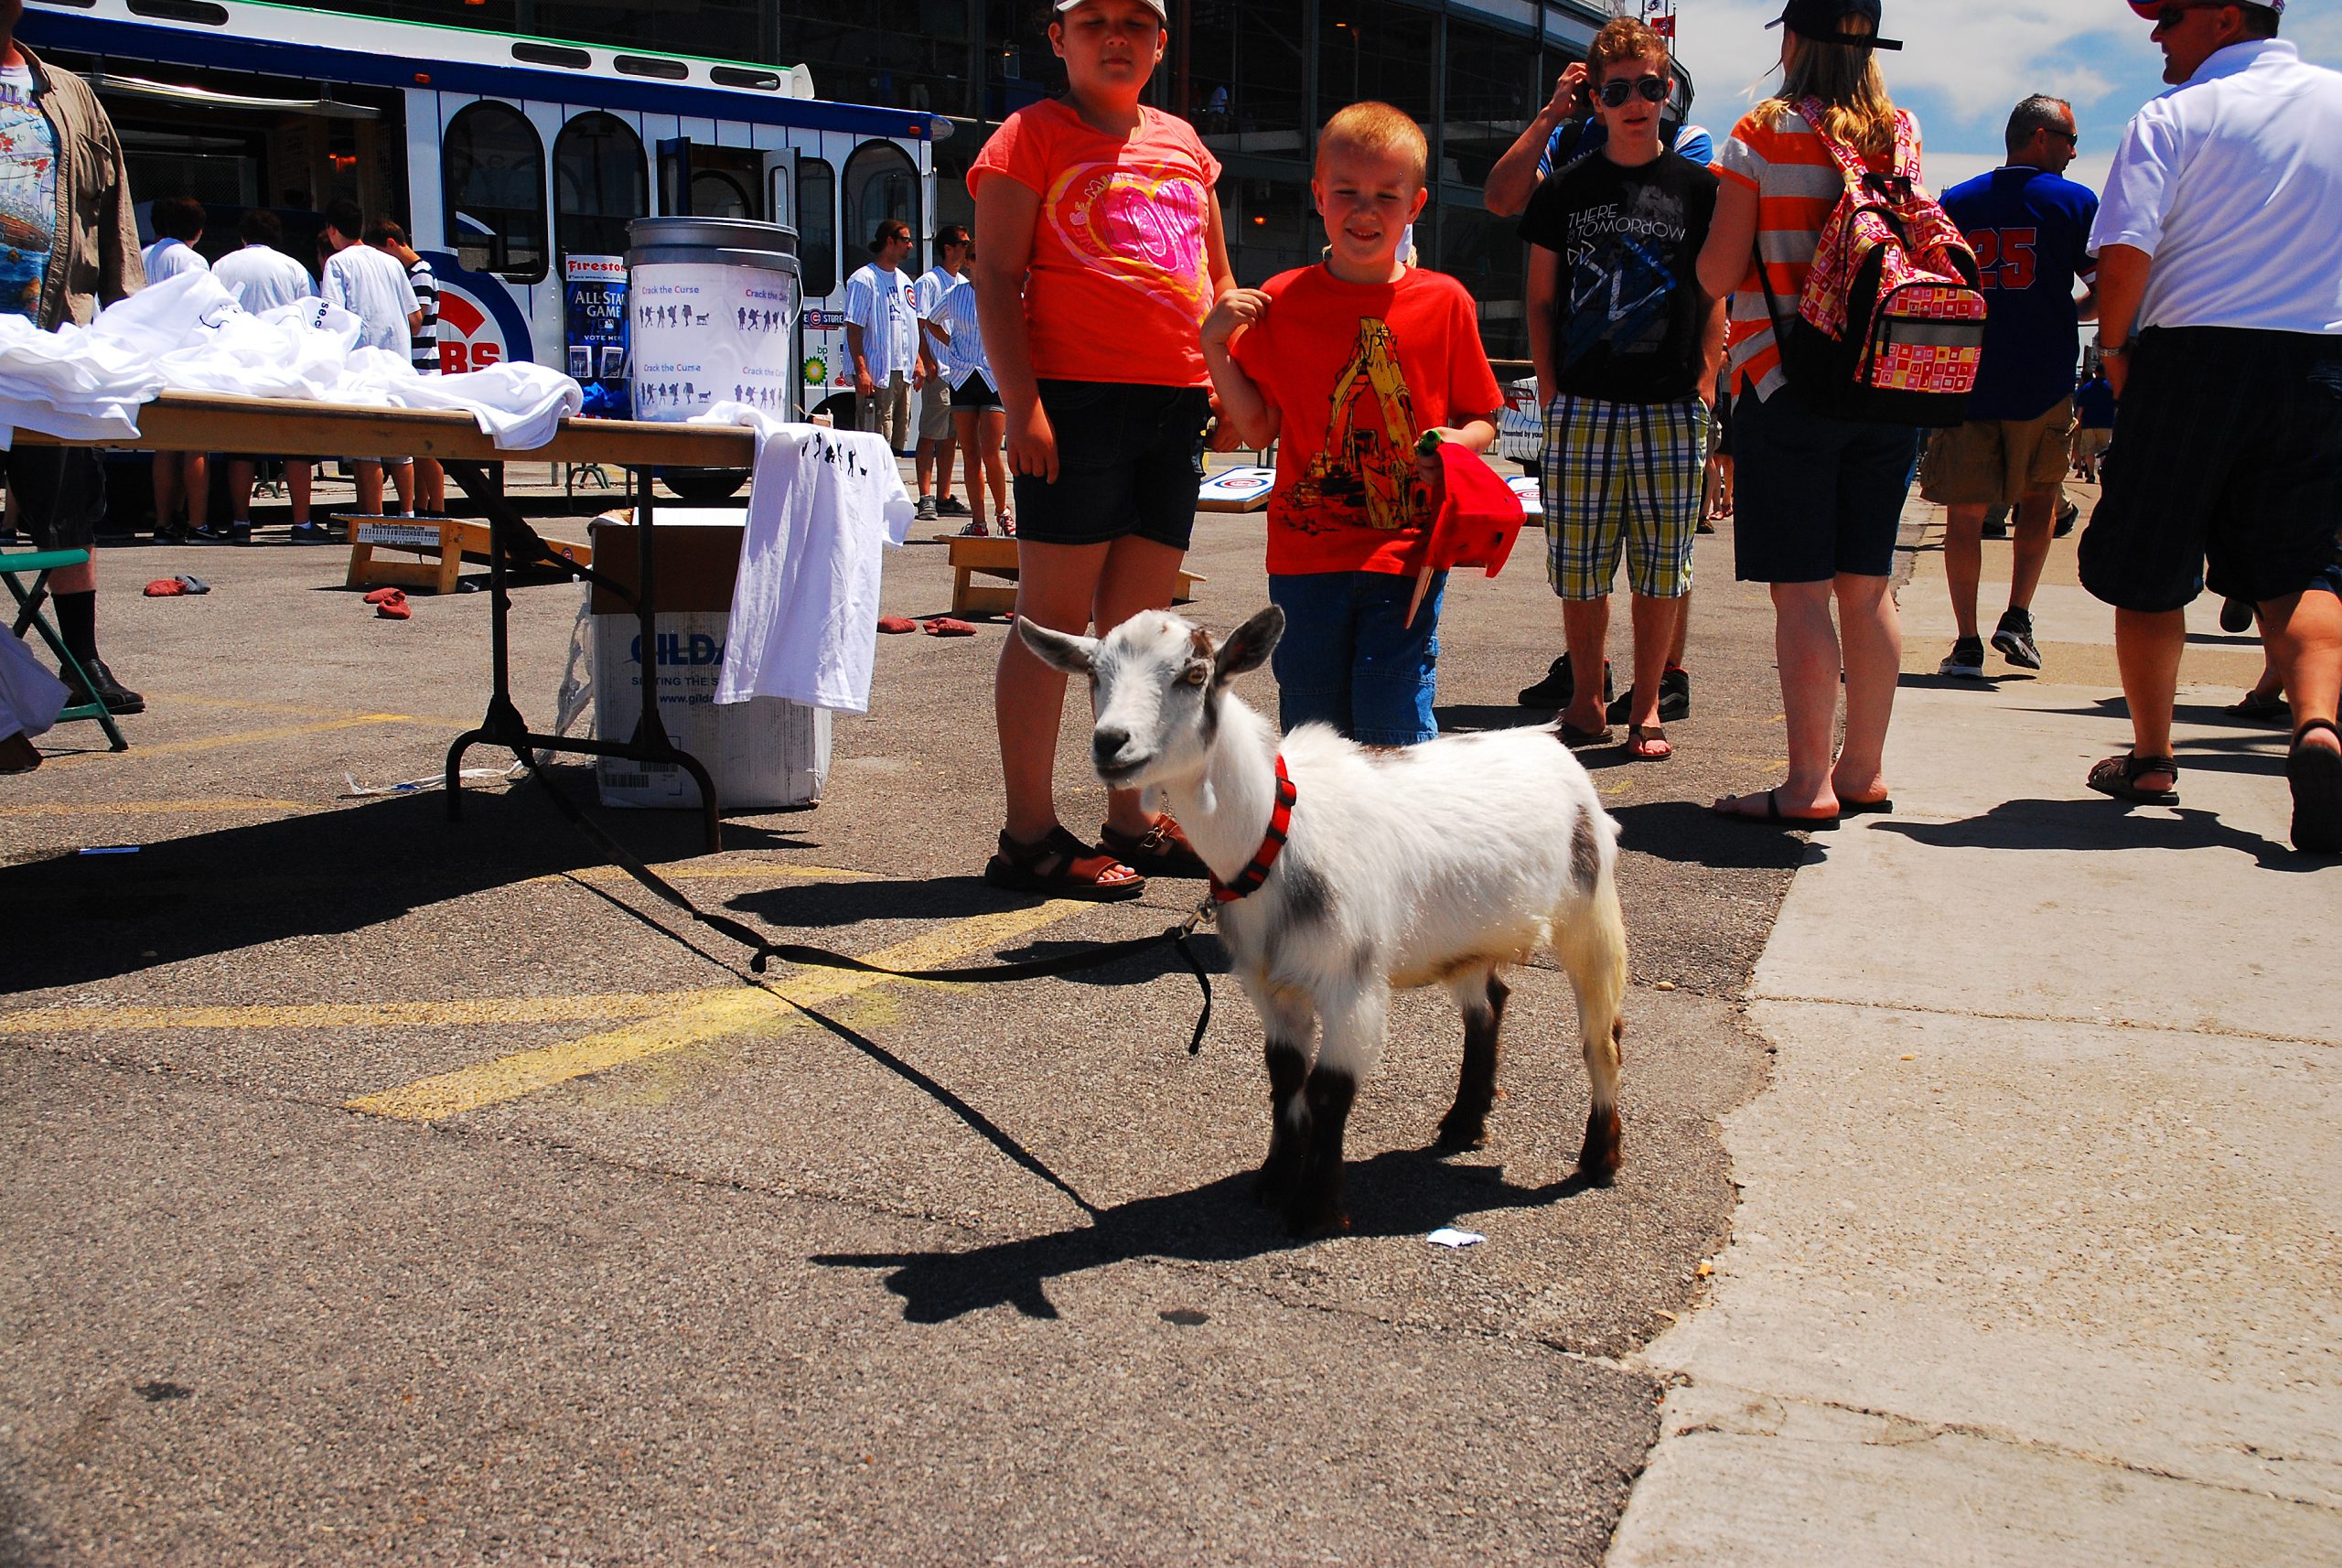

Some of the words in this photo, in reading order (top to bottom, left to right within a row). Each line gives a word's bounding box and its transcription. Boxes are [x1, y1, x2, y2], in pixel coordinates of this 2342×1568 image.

[1568, 203, 1618, 229] THERE
[1577, 217, 1686, 242] TOMORROW
[1964, 228, 2036, 289] 25
[642, 286, 658, 295] Crack
[660, 285, 672, 294] the
[674, 285, 700, 294] Curse
[746, 289, 766, 299] Crack
[586, 305, 621, 317] GAME
[823, 315, 843, 323] STORE
[817, 346, 828, 356] bp
[742, 367, 762, 375] Crack
[1524, 430, 1531, 438] by
[685, 677, 707, 685] THE
